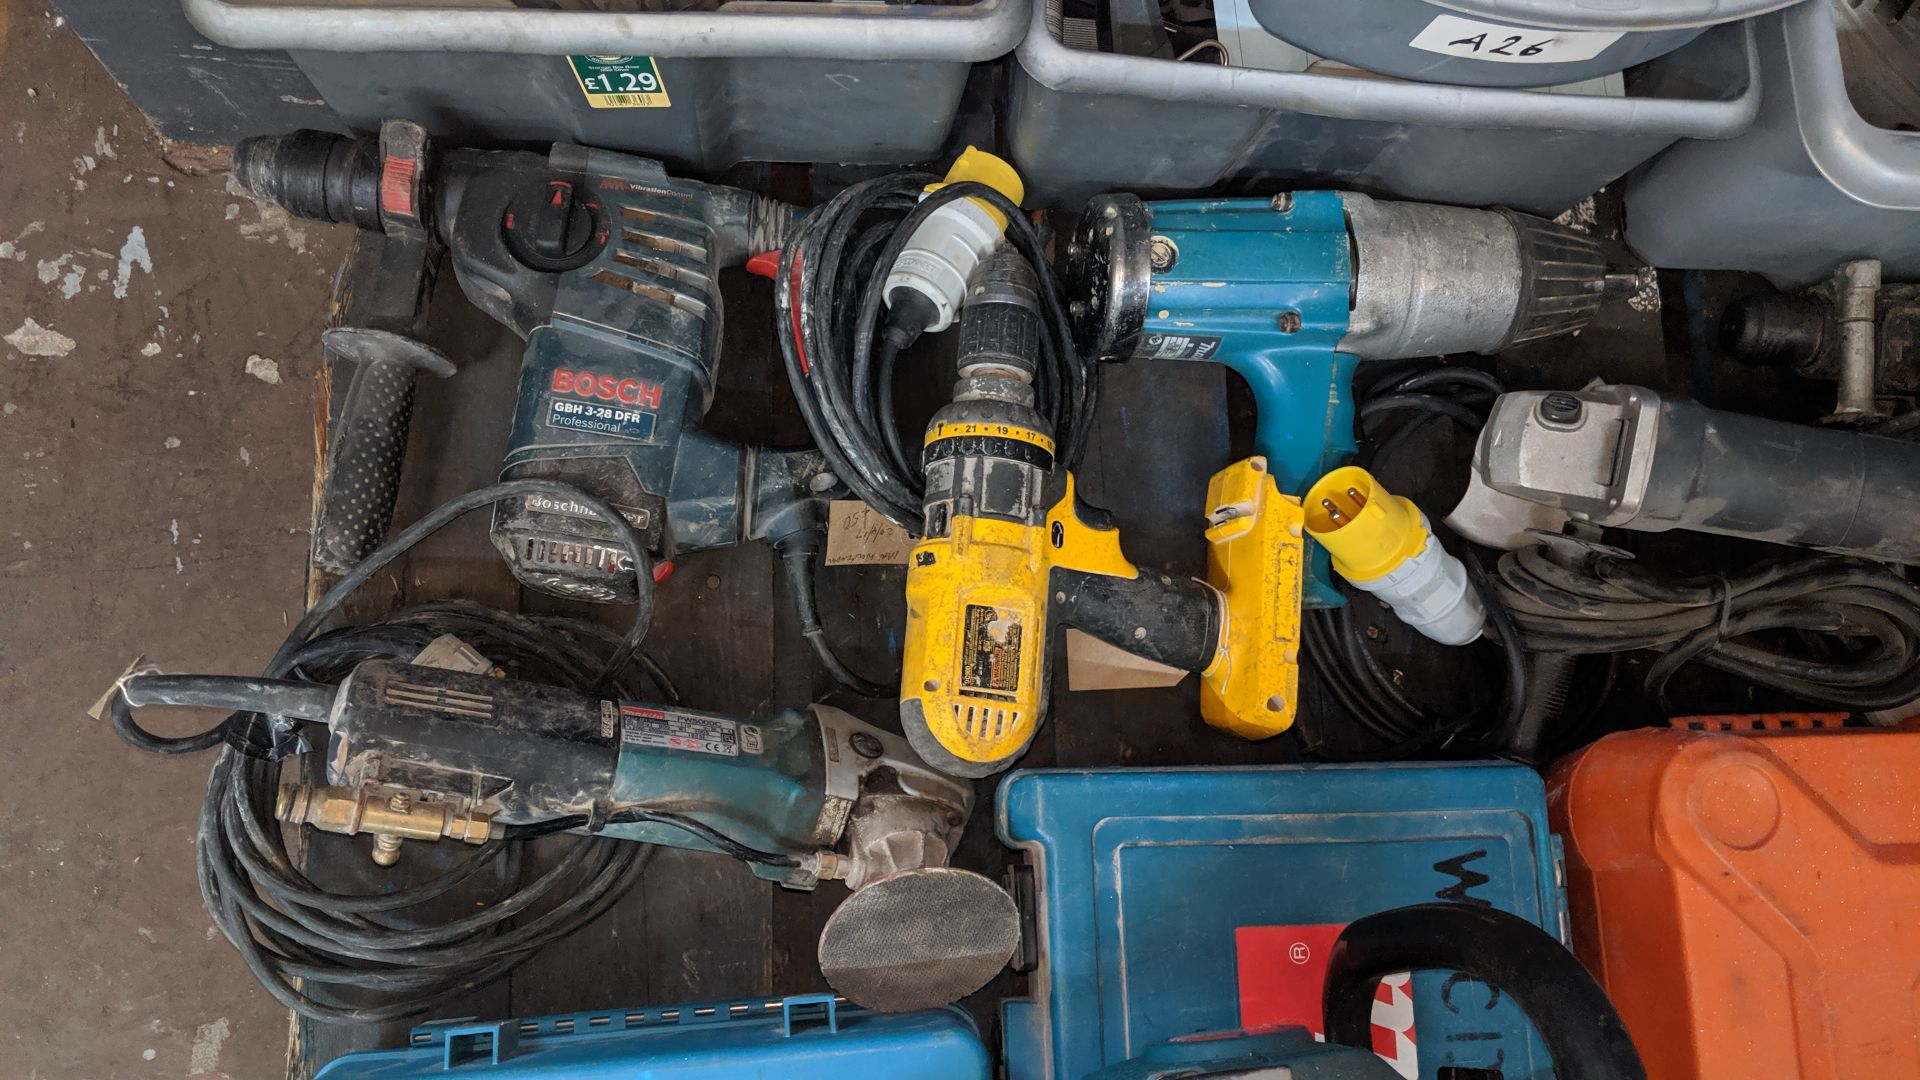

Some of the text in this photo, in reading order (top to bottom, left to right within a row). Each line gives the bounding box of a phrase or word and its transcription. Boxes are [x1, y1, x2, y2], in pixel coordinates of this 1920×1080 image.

[1448, 33, 1554, 56] A26
[584, 72, 657, 92] £1.29
[552, 367, 662, 409] BOSCH
[554, 402, 641, 423] GBH 3-28 DFR
[552, 413, 621, 433] Professional
[965, 425, 977, 433] 21
[996, 426, 1009, 435] 19
[1026, 431, 1036, 441] 17
